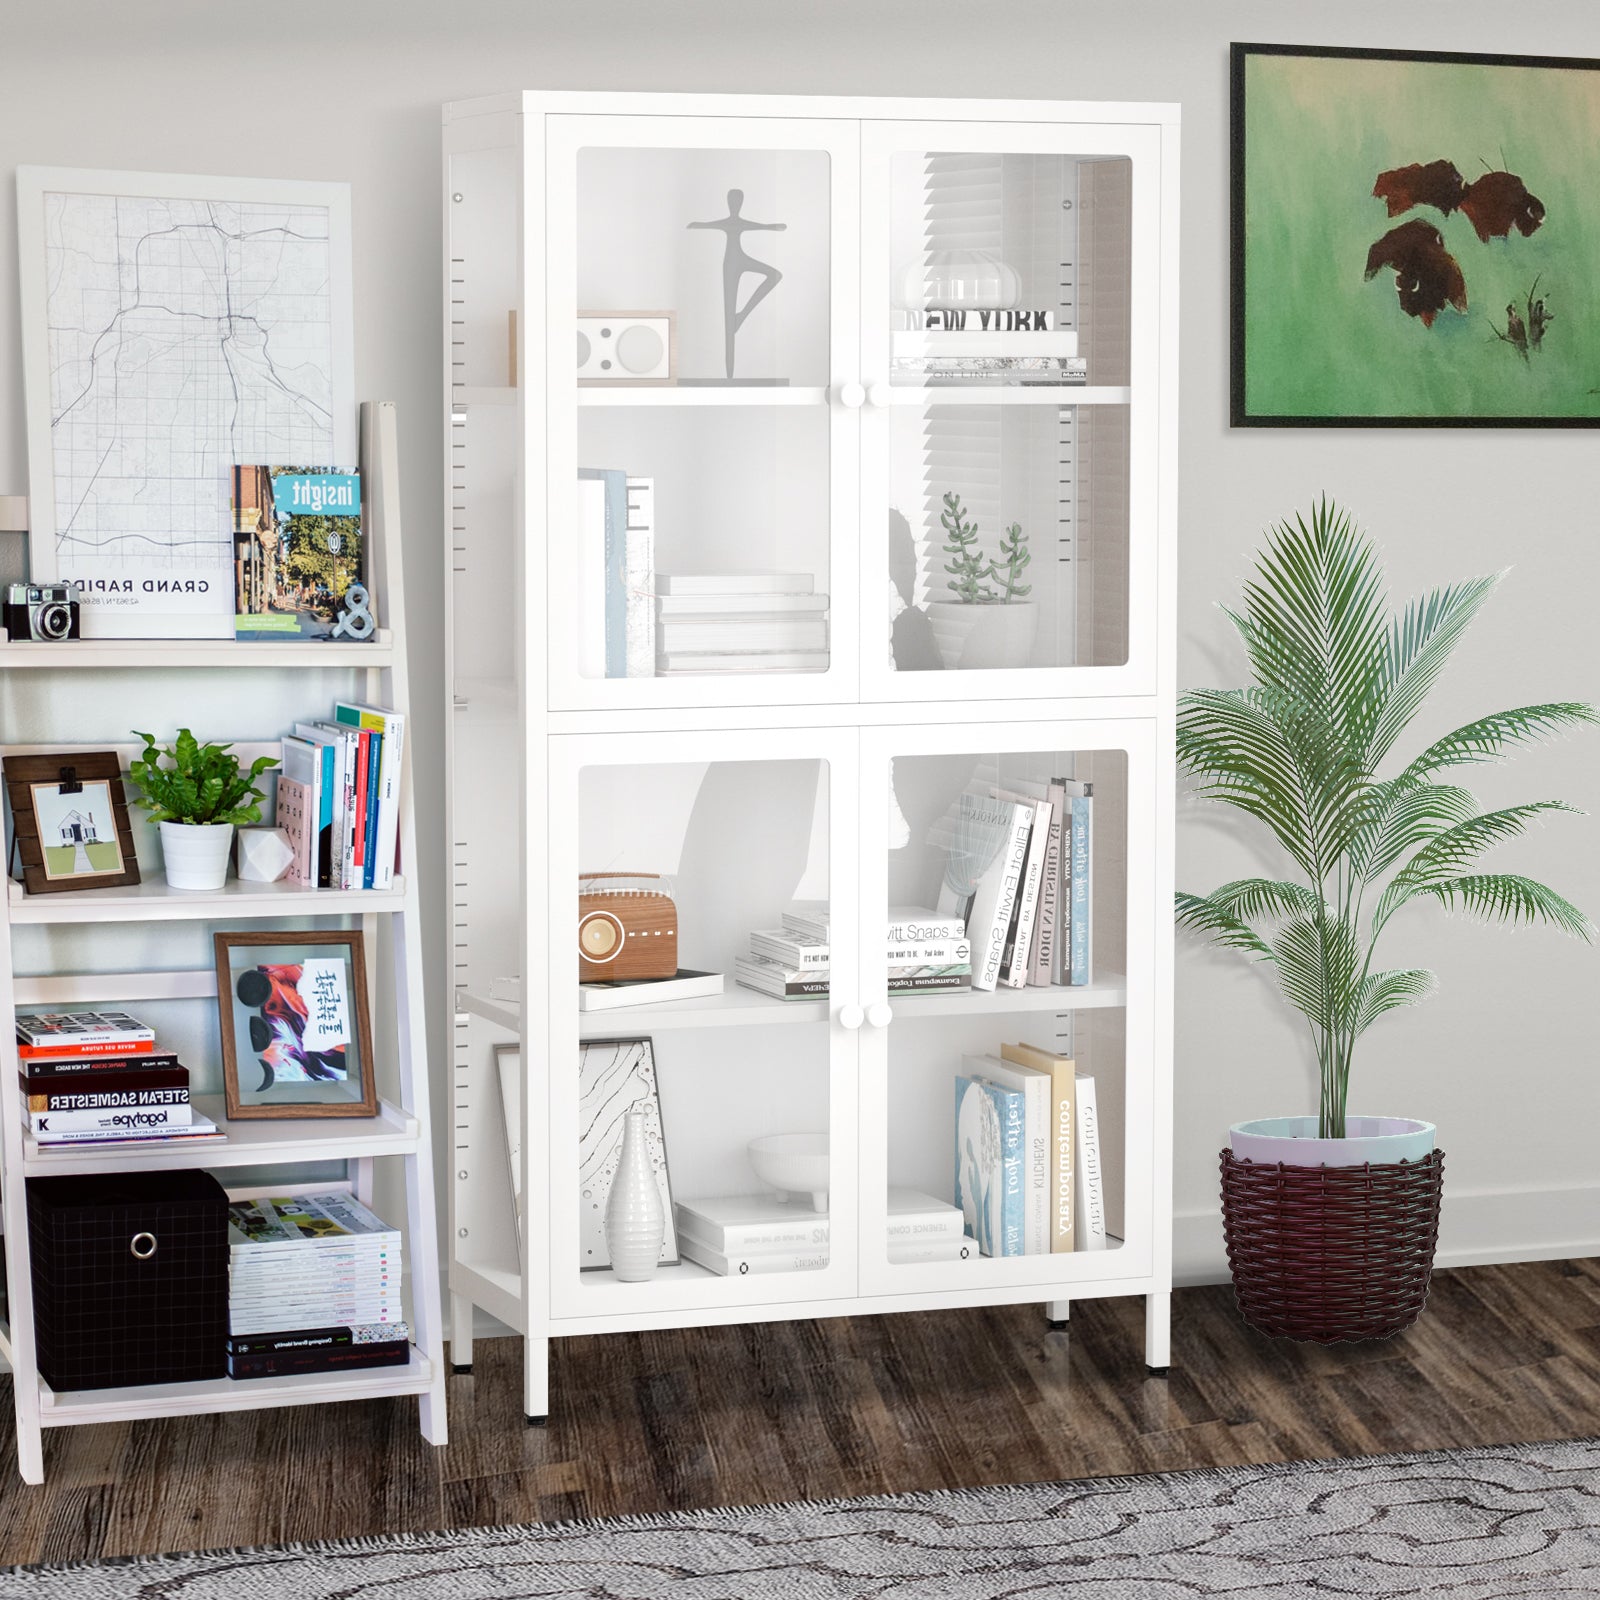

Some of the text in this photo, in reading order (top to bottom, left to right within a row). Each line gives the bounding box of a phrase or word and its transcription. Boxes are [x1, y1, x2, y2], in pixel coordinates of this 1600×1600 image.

[907, 924, 949, 940] Snaps
[812, 954, 820, 962] NOT
[915, 977, 961, 986] Екатерина
[912, 1224, 947, 1234] TERENCE
